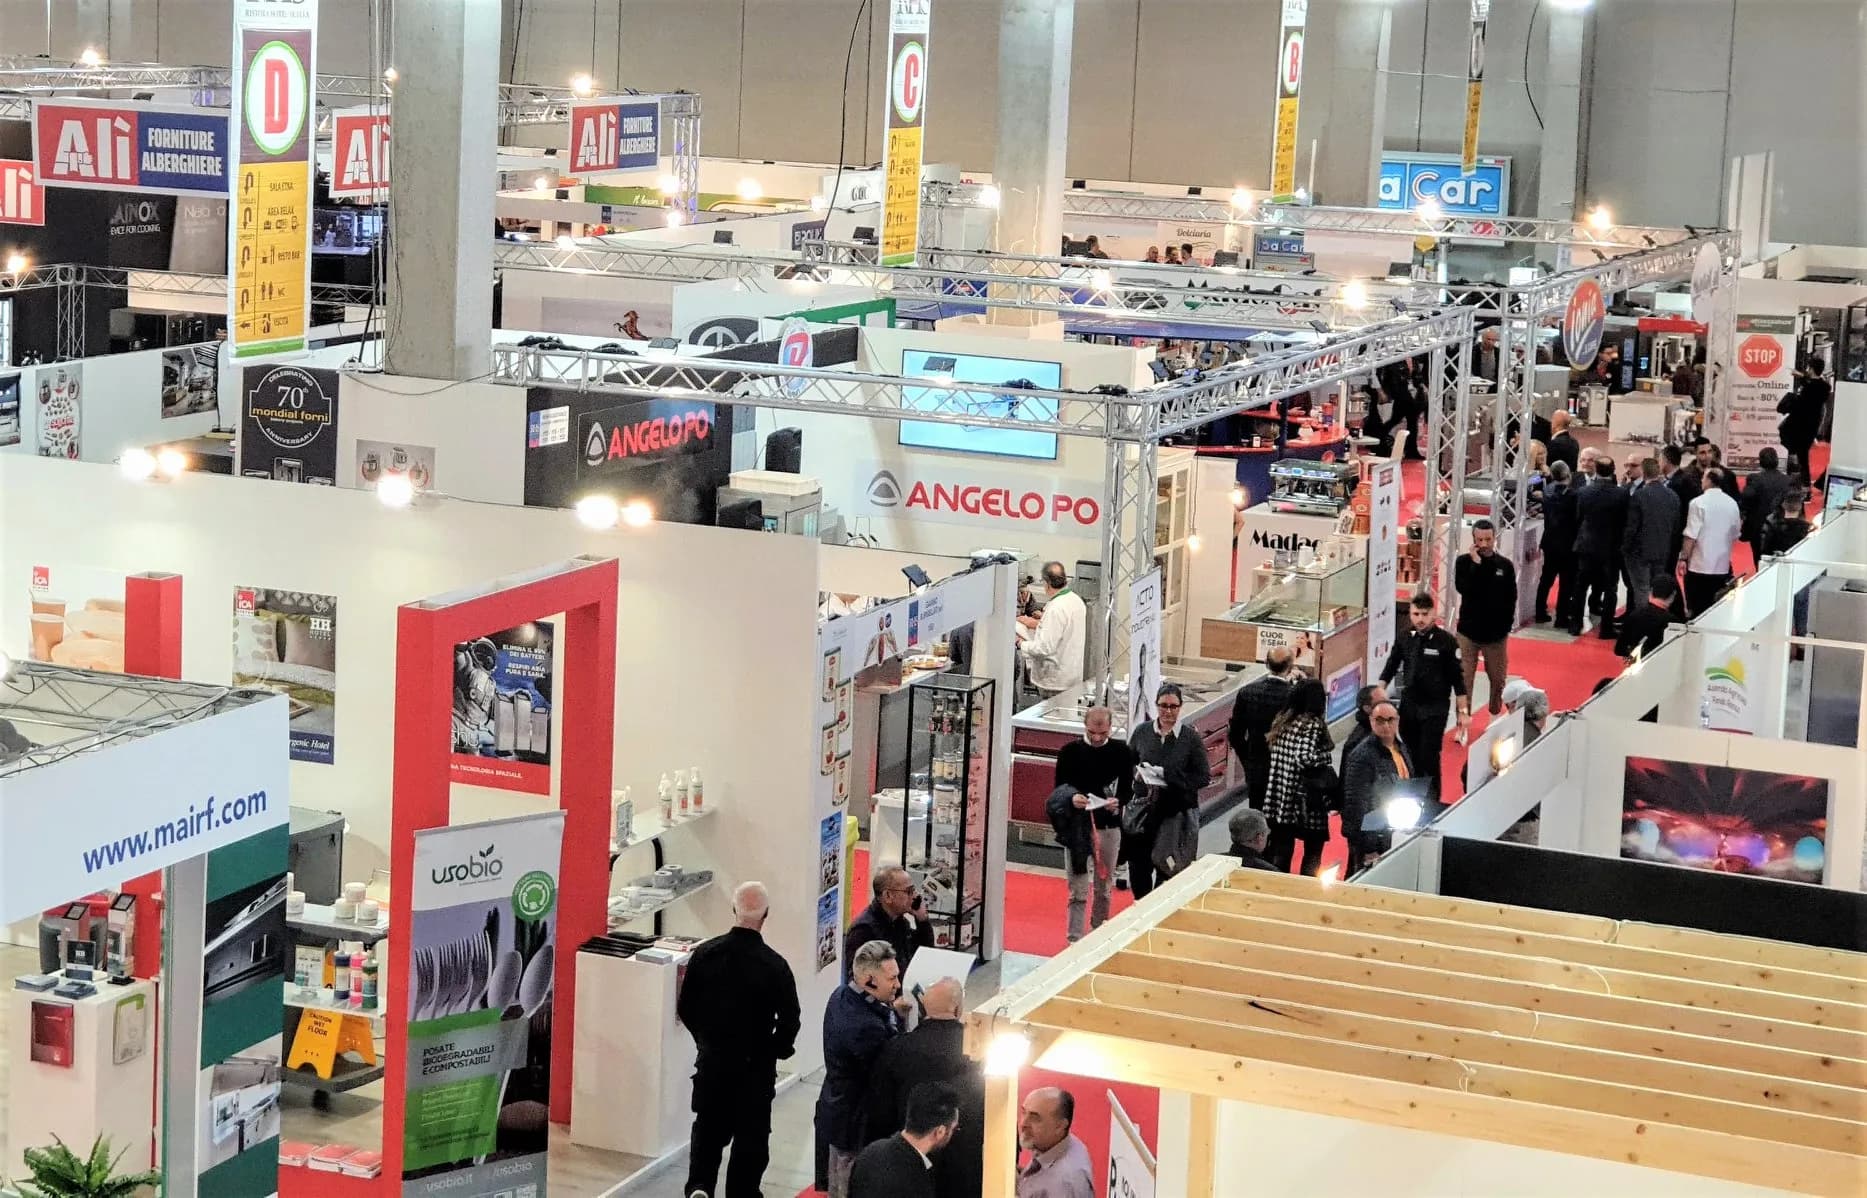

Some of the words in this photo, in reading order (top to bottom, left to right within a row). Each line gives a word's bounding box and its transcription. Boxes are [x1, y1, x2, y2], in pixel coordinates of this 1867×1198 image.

[1289, 42, 1299, 82] B
[904, 53, 919, 108] C
[264, 59, 289, 134] D
[623, 116, 653, 134] FORNITURE
[148, 127, 215, 152] FORNITURE
[619, 137, 657, 155] ALBERGHIERE
[141, 151, 224, 177] ALBERGHIERE
[0, 167, 33, 219] lì
[1412, 170, 1492, 205] Car
[1744, 348, 1777, 364] STOP
[268, 370, 314, 387] CELEBRATING
[1757, 380, 1790, 390] Online
[252, 407, 298, 420] mondial
[301, 411, 329, 422] forni
[265, 427, 313, 444] ANNIVERSARY
[608, 415, 683, 460] ANGELO
[684, 409, 709, 444] PO
[905, 481, 1045, 519] ANGELO
[1051, 494, 1100, 524] PO
[310, 617, 331, 631] HH
[1260, 630, 1284, 640] CUOR
[312, 740, 330, 750] Hotel
[460, 765, 494, 775] TECNOLOGIA
[83, 790, 267, 874] www.mairf.com
[432, 852, 503, 885] usobio
[309, 1013, 332, 1023] CAUTION
[308, 1026, 328, 1036] FLOOR
[423, 1045, 495, 1066] BIODEGRADABILI
[424, 1043, 455, 1057] POSATE
[429, 1055, 491, 1075] COMPOSTABILI
[426, 1174, 473, 1193] usobio.it
